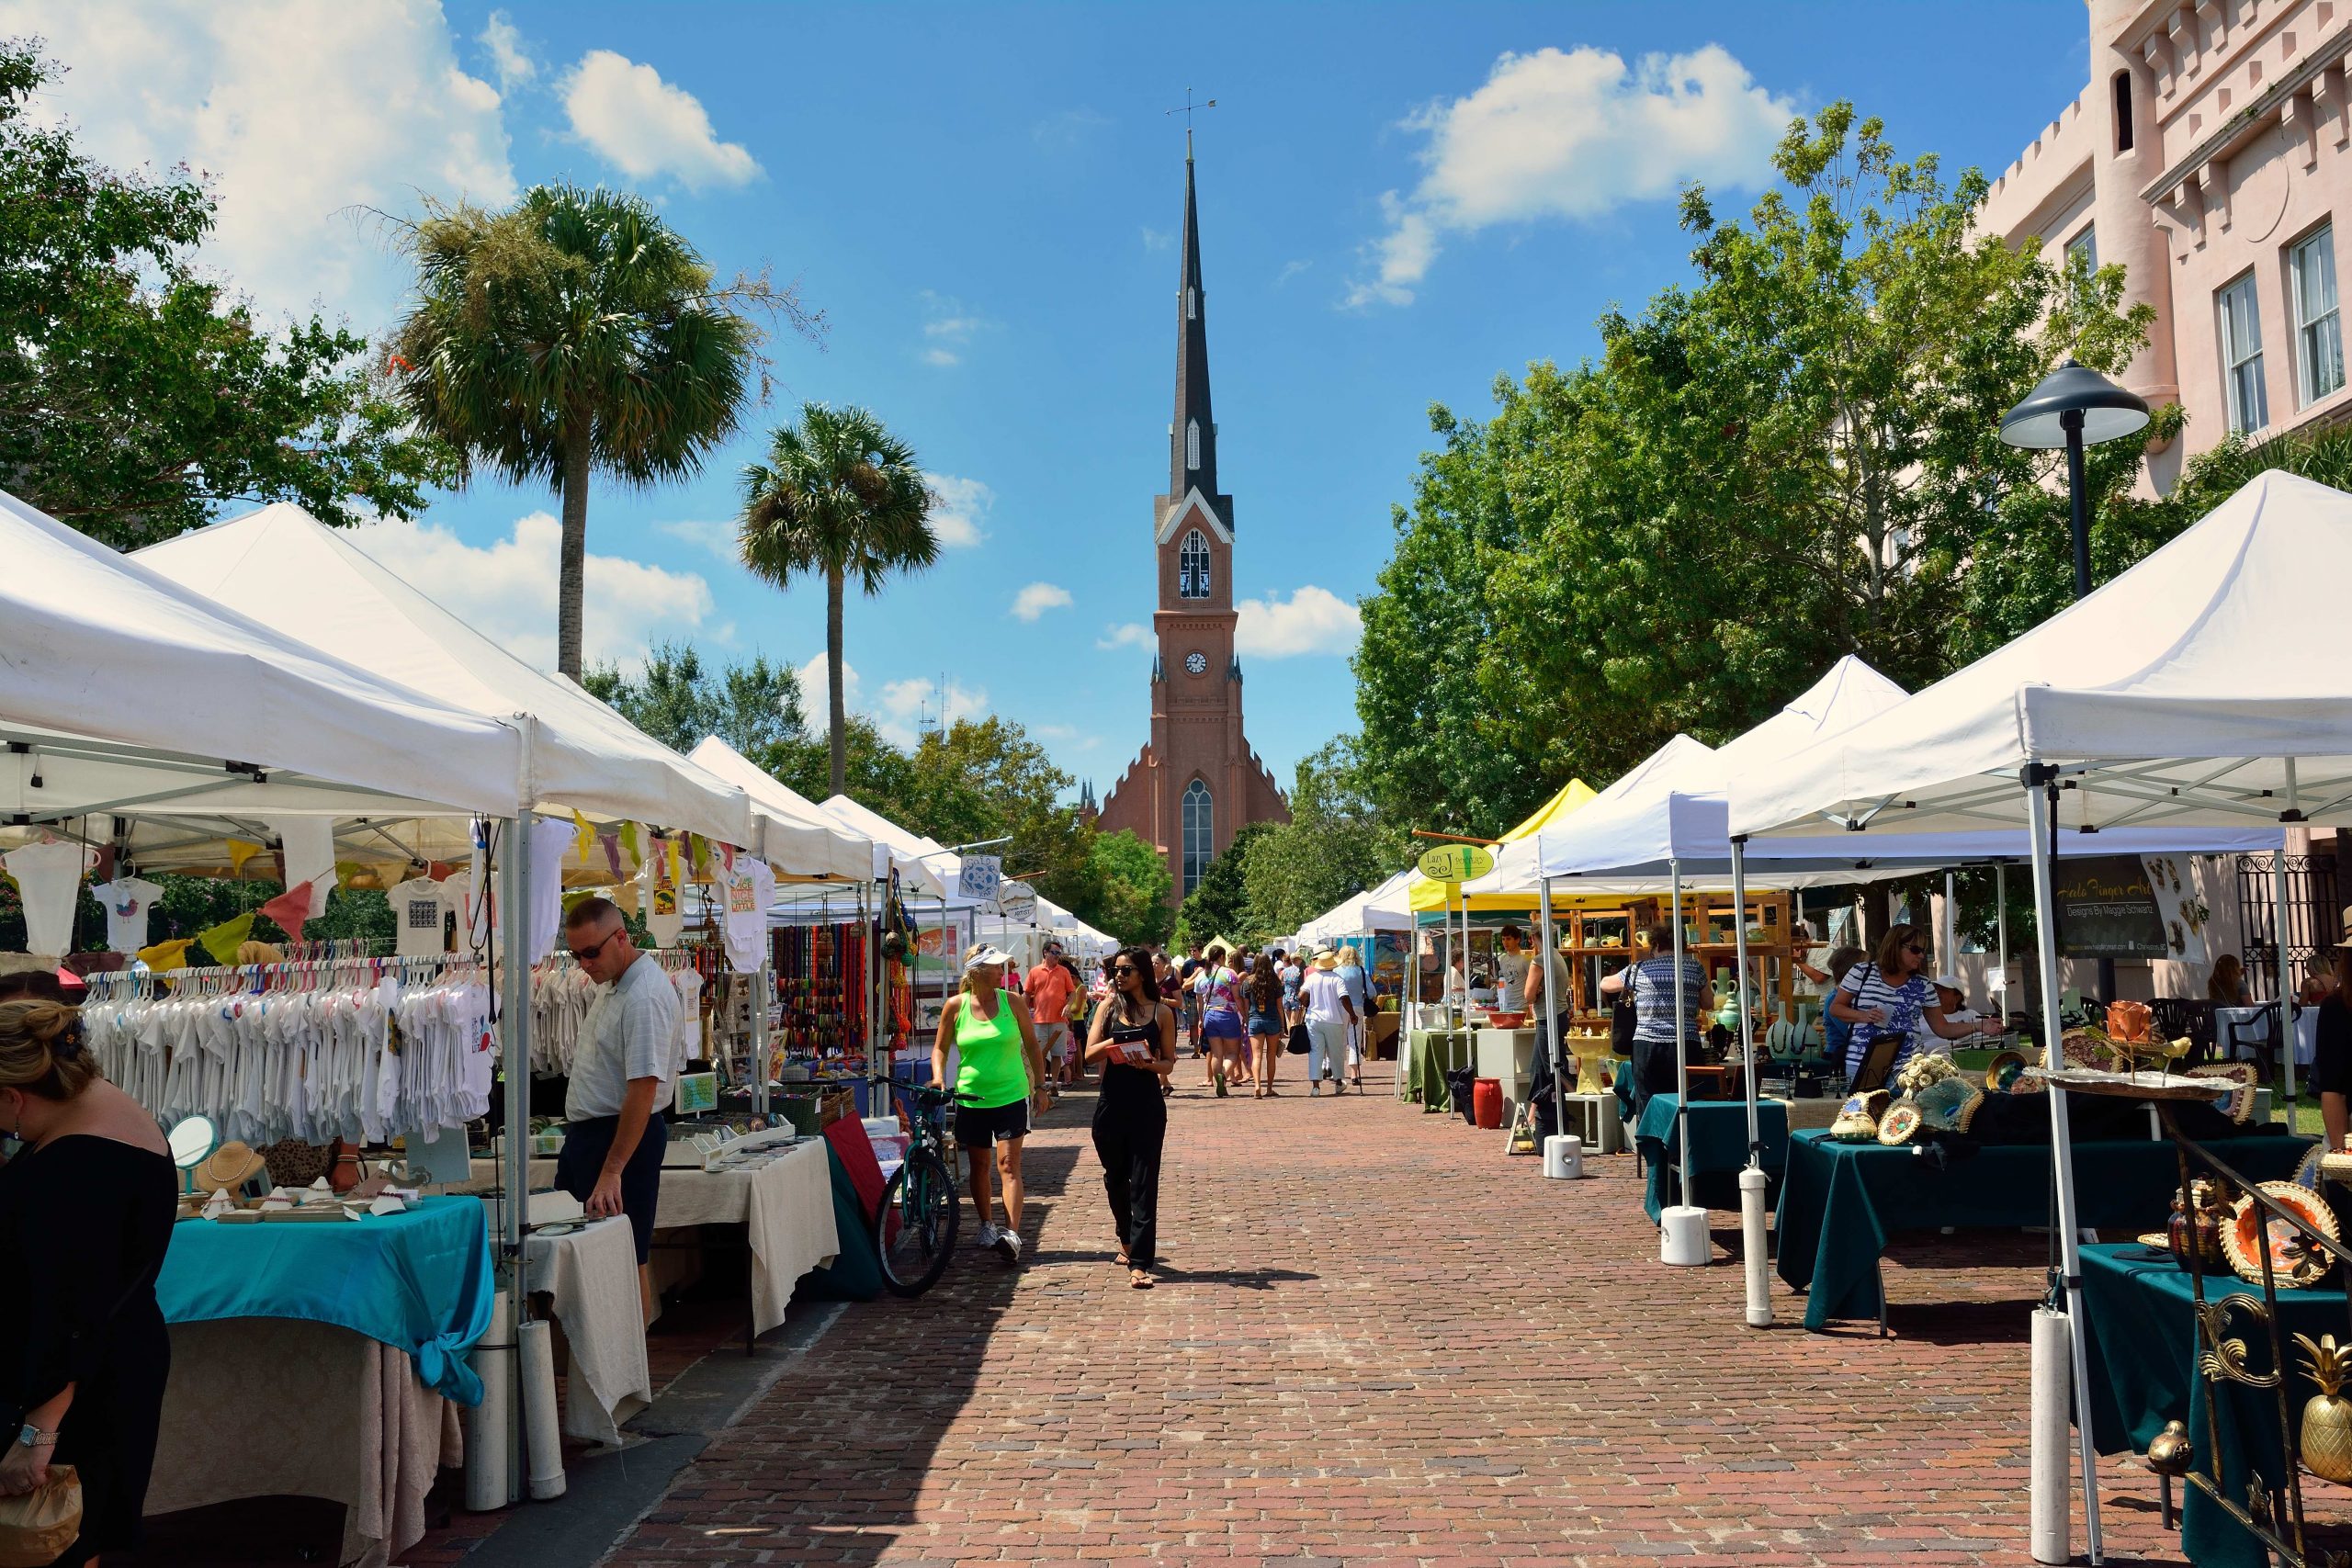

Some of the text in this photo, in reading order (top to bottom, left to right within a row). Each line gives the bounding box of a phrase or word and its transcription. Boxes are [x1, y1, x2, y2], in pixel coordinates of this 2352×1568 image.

[1427, 852, 1442, 865] Lazy
[731, 890, 753, 899] NICE
[2087, 878, 2125, 902] Finger
[2127, 875, 2153, 897] Art
[2066, 904, 2154, 919] Designs By Maggie Schwartz
